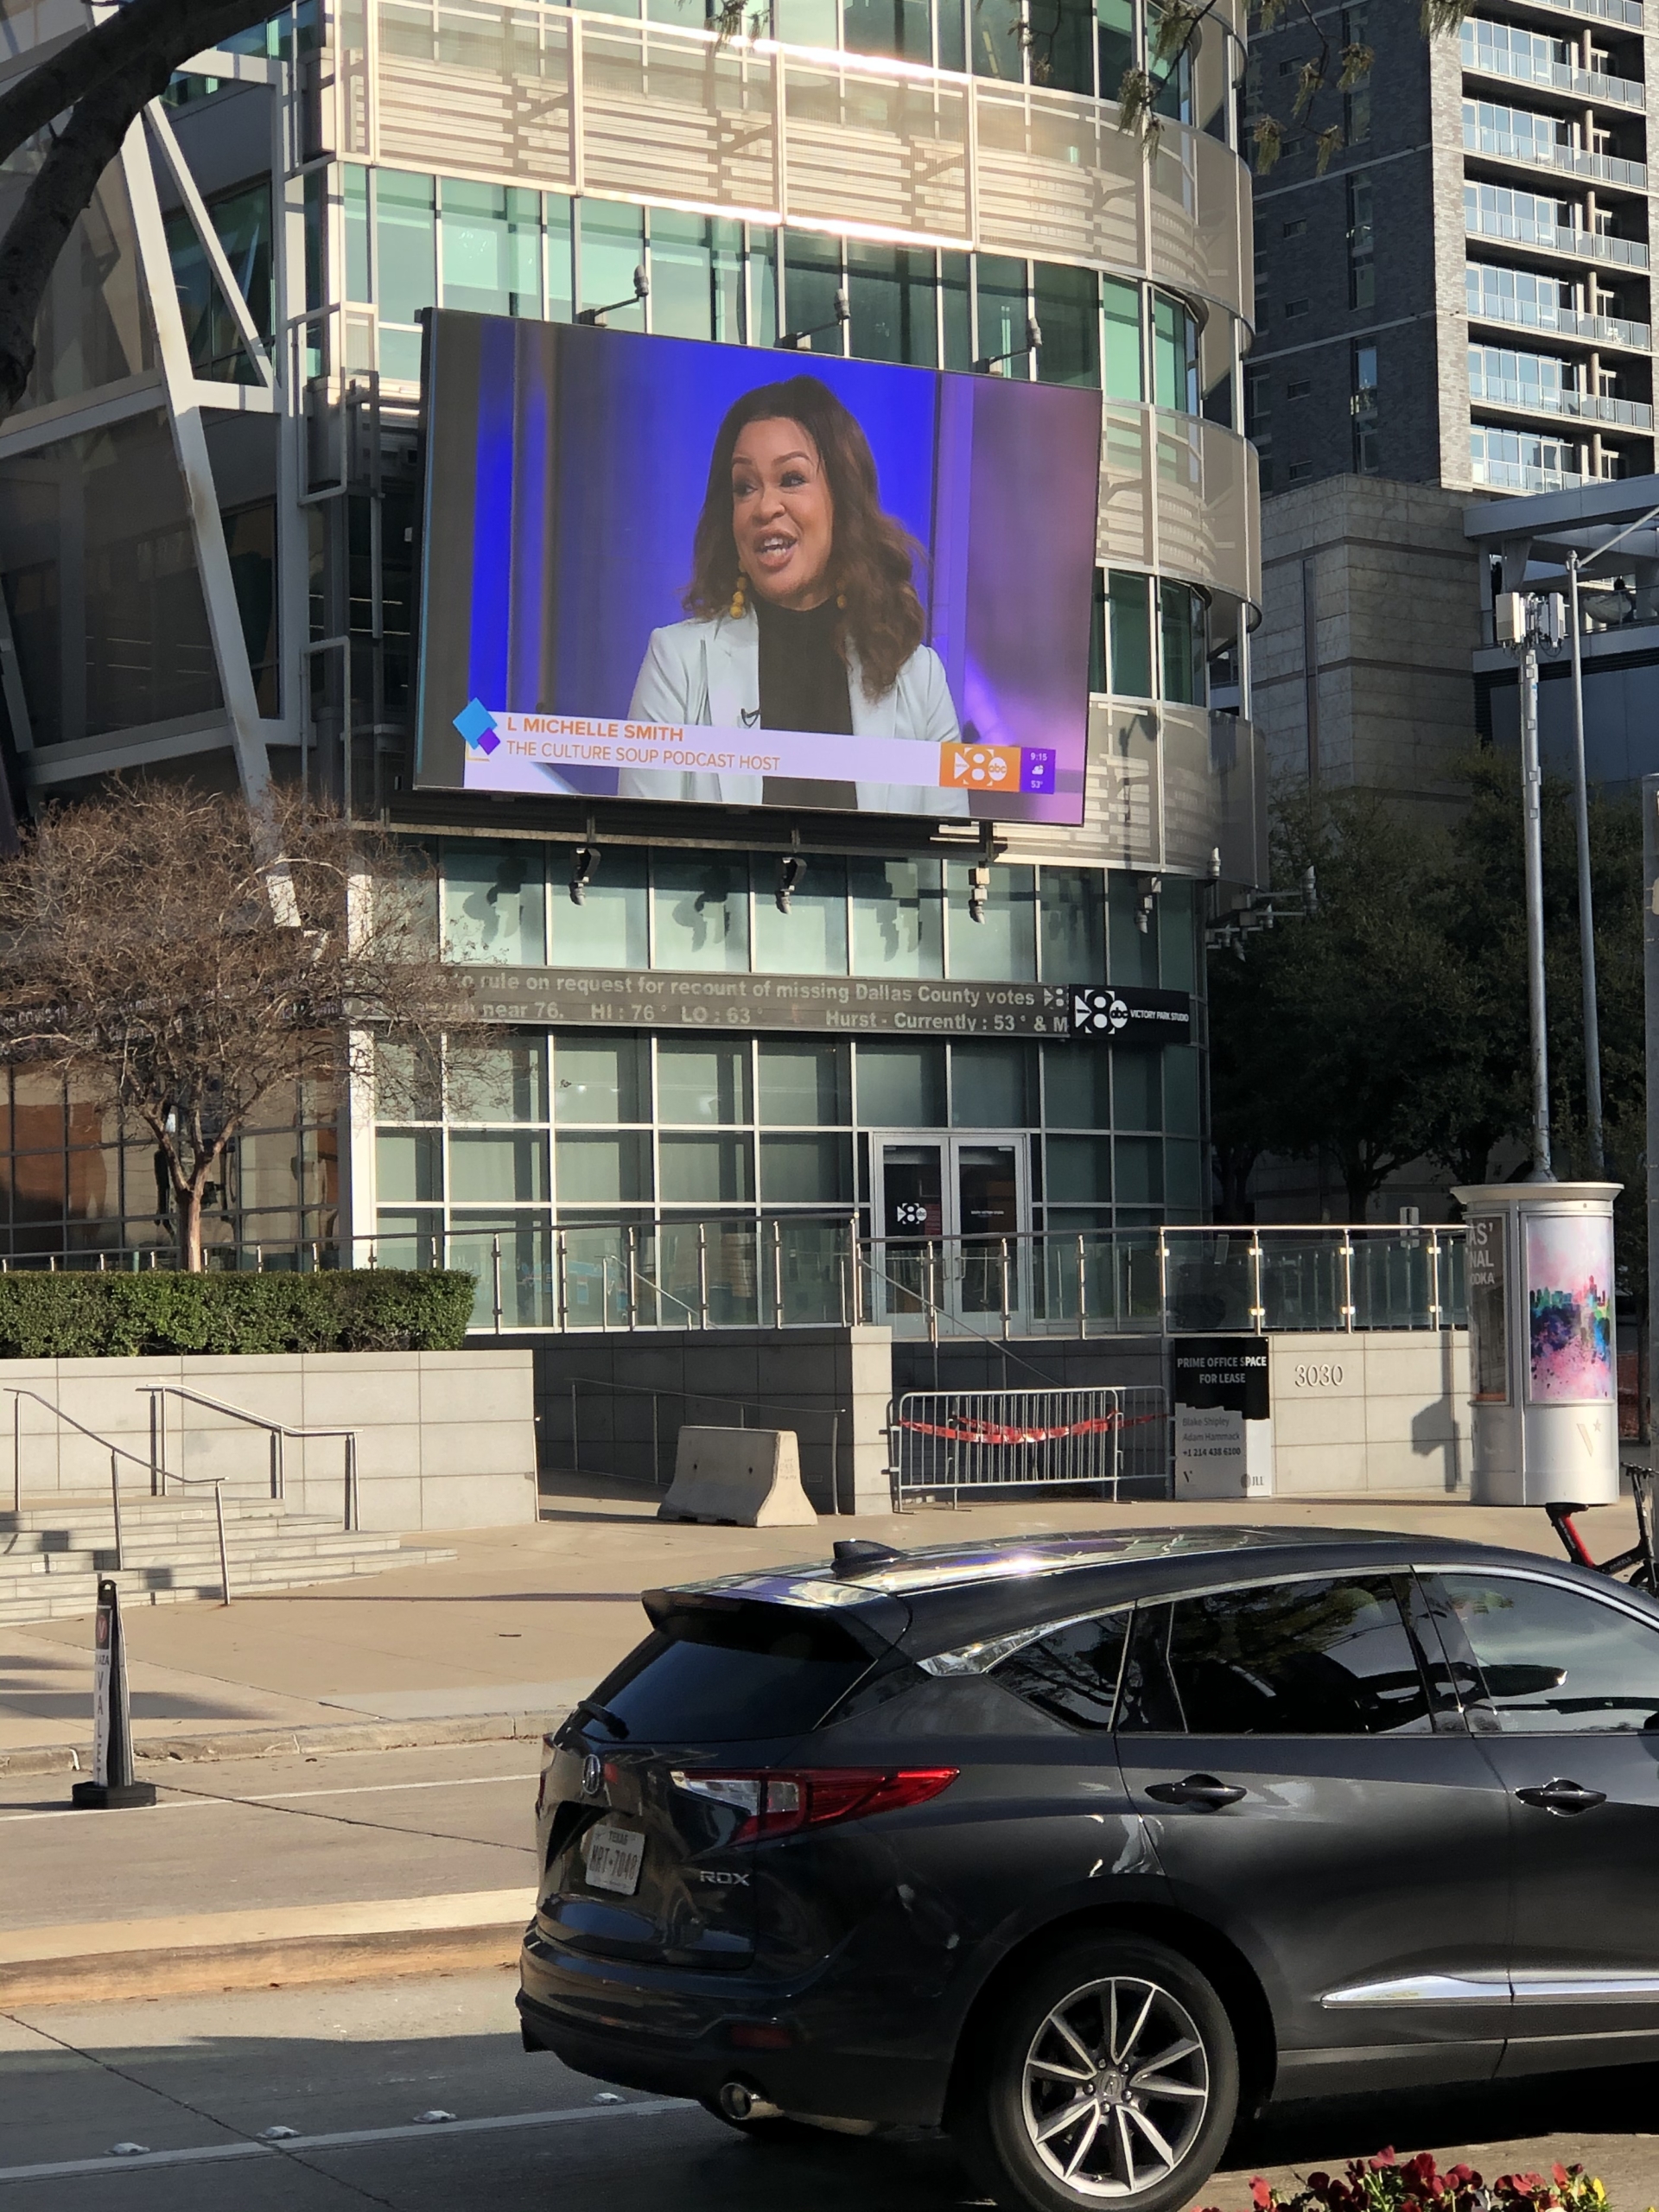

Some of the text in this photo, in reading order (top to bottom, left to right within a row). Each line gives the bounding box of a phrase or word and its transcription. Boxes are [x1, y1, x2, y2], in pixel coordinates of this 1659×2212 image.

[507, 716, 683, 742] L MICHELLE SMITH
[506, 741, 780, 771] THE CULTURE SOUP PODCAST HOST
[1030, 753, 1047, 761] 9:15
[480, 972, 519, 989] rule
[526, 976, 550, 990] on
[556, 977, 632, 996] request
[638, 976, 664, 994] for
[671, 981, 747, 996] recount
[753, 980, 771, 997] of
[777, 982, 849, 1004] missing
[855, 983, 912, 1001] Dallas
[918, 985, 980, 1007] County
[986, 989, 1035, 1006] votes
[481, 1003, 528, 1018] near
[534, 1001, 564, 1019] 76.
[826, 1009, 877, 1027] Hurst
[894, 1012, 976, 1032] Currently
[1033, 1015, 1046, 1032] &
[1110, 1007, 1128, 1020] abc
[1129, 1009, 1156, 1020] VICTORY
[1156, 1011, 1170, 1020] PARK
[1171, 1013, 1190, 1022] STUDIO
[1177, 1357, 1267, 1368] PRIME OFFICE SPACE
[1199, 1373, 1246, 1384] FOR LEASE
[1294, 1363, 1344, 1388] 3030
[1182, 1417, 1230, 1427] Blake Shipley
[1182, 1433, 1240, 1441] Adam Hammack
[1193, 1448, 1207, 1457] 214
[1223, 1447, 1242, 1456] 6100
[608, 1831, 628, 1846] TEXAS
[700, 1870, 750, 1887] RDX
